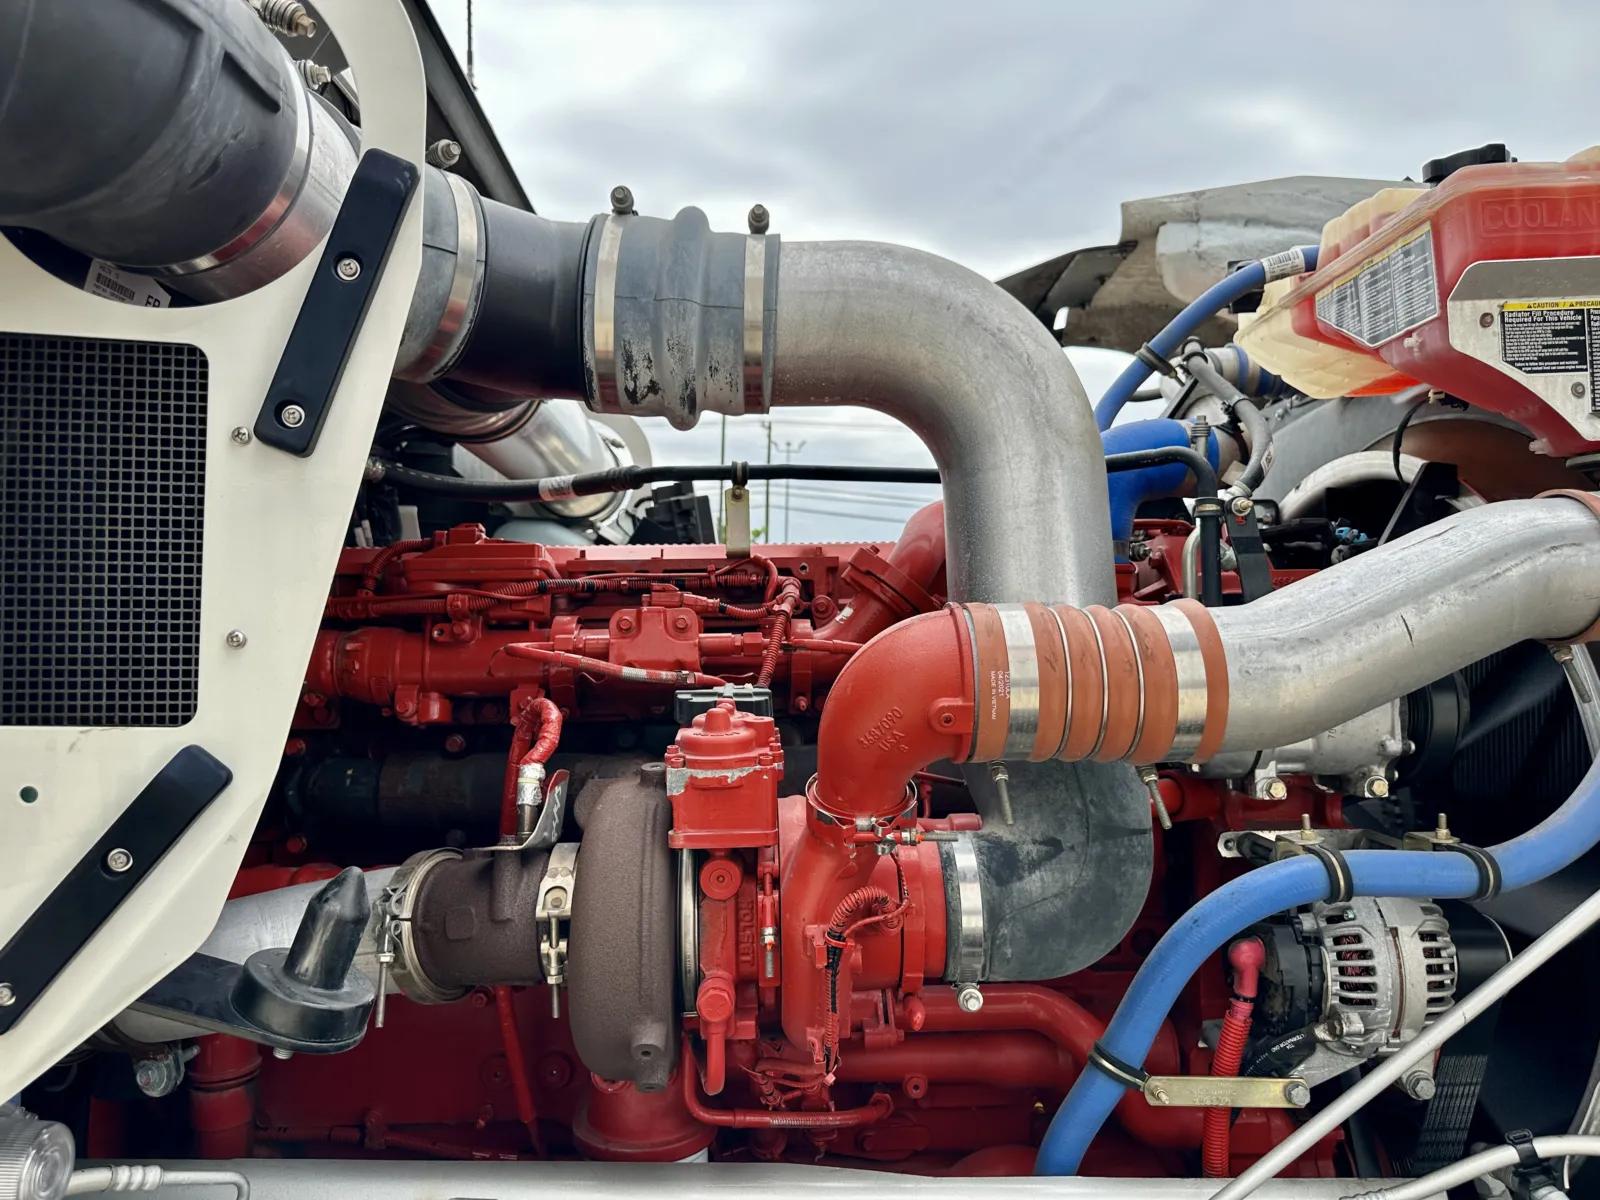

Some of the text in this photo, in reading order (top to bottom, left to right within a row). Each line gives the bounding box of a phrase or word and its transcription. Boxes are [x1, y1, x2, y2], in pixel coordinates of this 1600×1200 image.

[1483, 200, 1600, 230] COOLAN
[878, 730, 905, 751] USA
[739, 899, 756, 968] HOLSET
